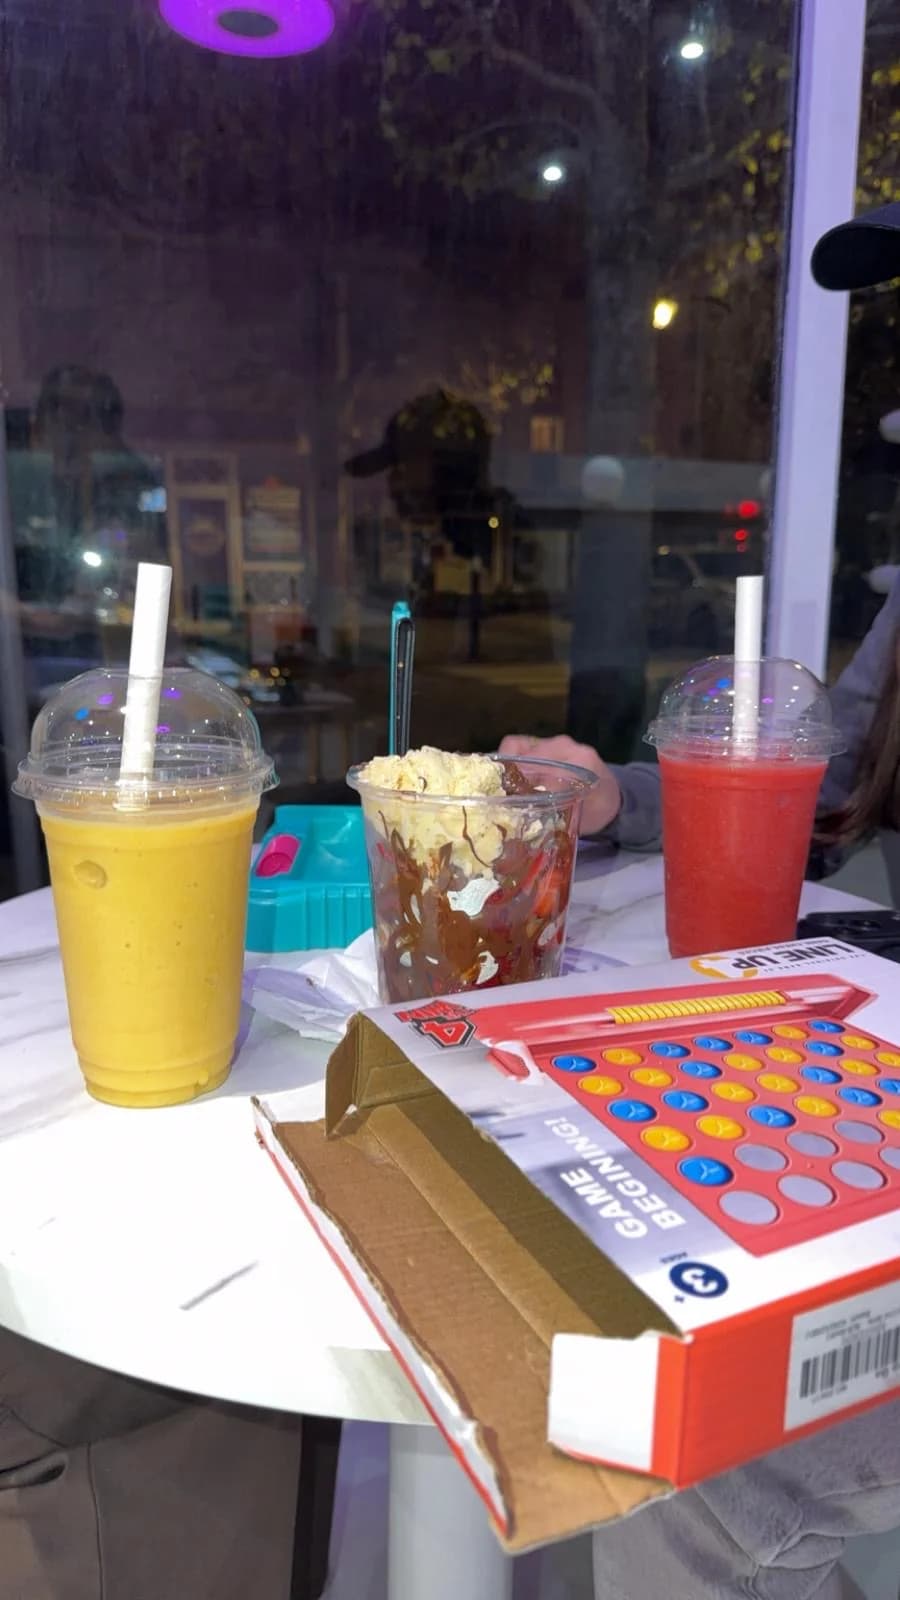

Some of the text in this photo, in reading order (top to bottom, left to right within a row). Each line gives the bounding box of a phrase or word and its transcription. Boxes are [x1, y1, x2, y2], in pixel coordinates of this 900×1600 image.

[731, 954, 779, 970] UP
[774, 943, 854, 962] LINE
[544, 1117, 687, 1230] BEGINING!
[560, 1167, 648, 1238] GAME
